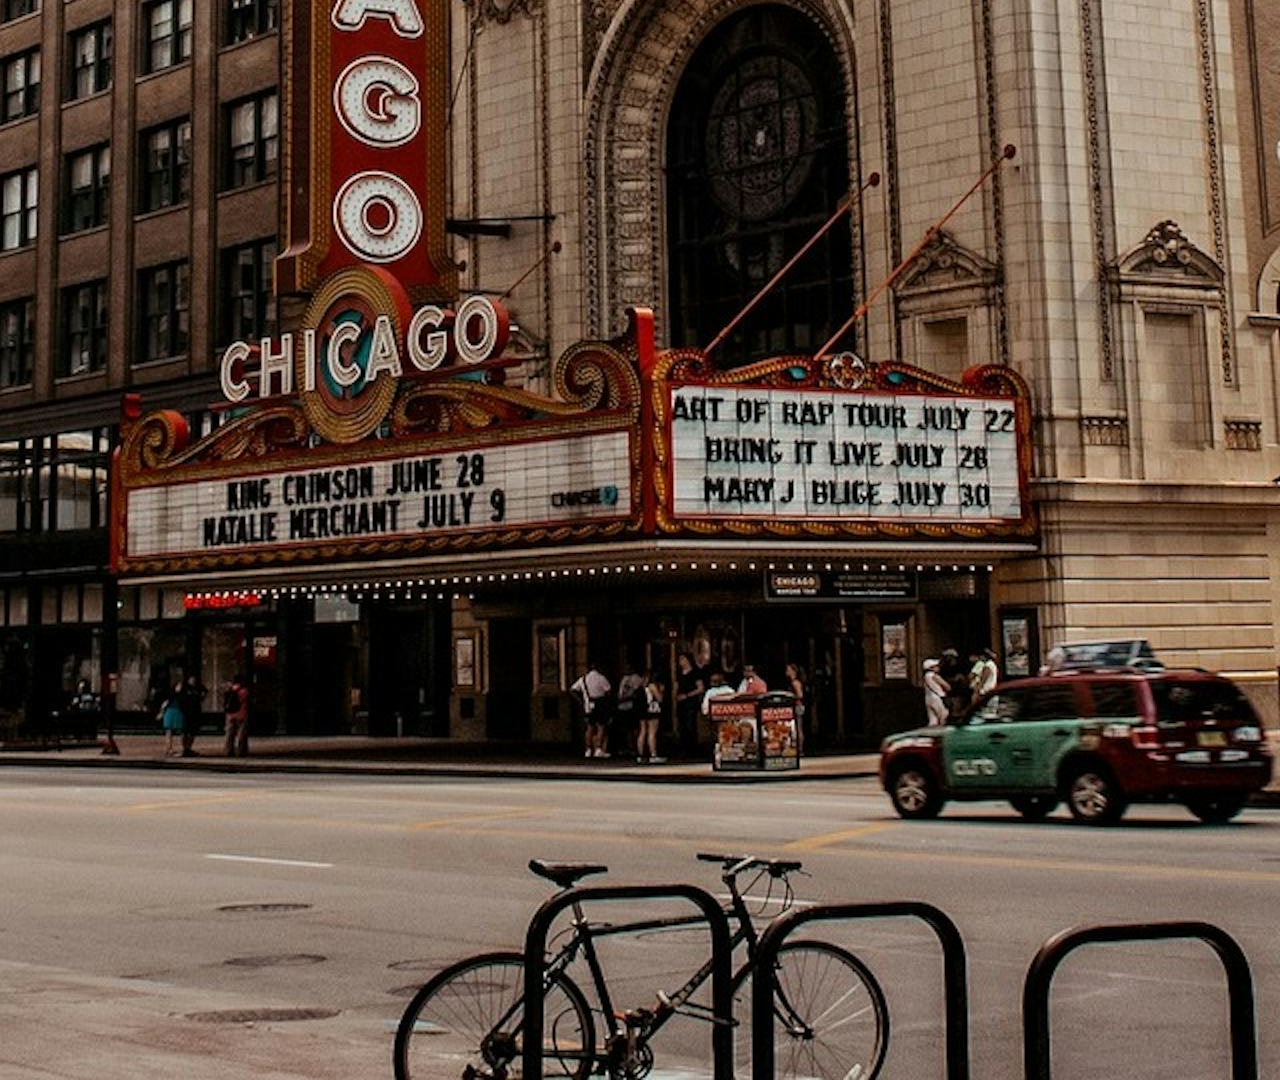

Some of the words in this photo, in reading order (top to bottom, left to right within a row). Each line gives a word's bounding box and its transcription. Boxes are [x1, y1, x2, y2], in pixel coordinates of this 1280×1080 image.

[220, 295, 499, 403] CHICAGO
[673, 395, 724, 422] ART
[736, 397, 769, 423] OF
[782, 400, 834, 426] RAP
[842, 402, 908, 429] TOUR
[917, 405, 970, 432] JULY
[984, 407, 1016, 433] 22
[705, 435, 783, 464] BRING
[794, 439, 818, 465] IT
[828, 440, 883, 467] LIVE
[890, 442, 945, 469] JULY
[959, 444, 989, 470] 28
[227, 478, 271, 511] KING
[282, 466, 374, 506] CRIMSON
[386, 458, 443, 496] JUNE
[456, 453, 485, 488] 28
[704, 475, 775, 503] MARY
[780, 479, 795, 504] J
[812, 479, 883, 506] BLIGE
[892, 480, 947, 507] JULY
[959, 483, 990, 508] 30
[203, 512, 278, 546] NATALIE
[289, 499, 401, 540] MERCHANT
[417, 491, 475, 529] JULY
[490, 488, 506, 523] 9
